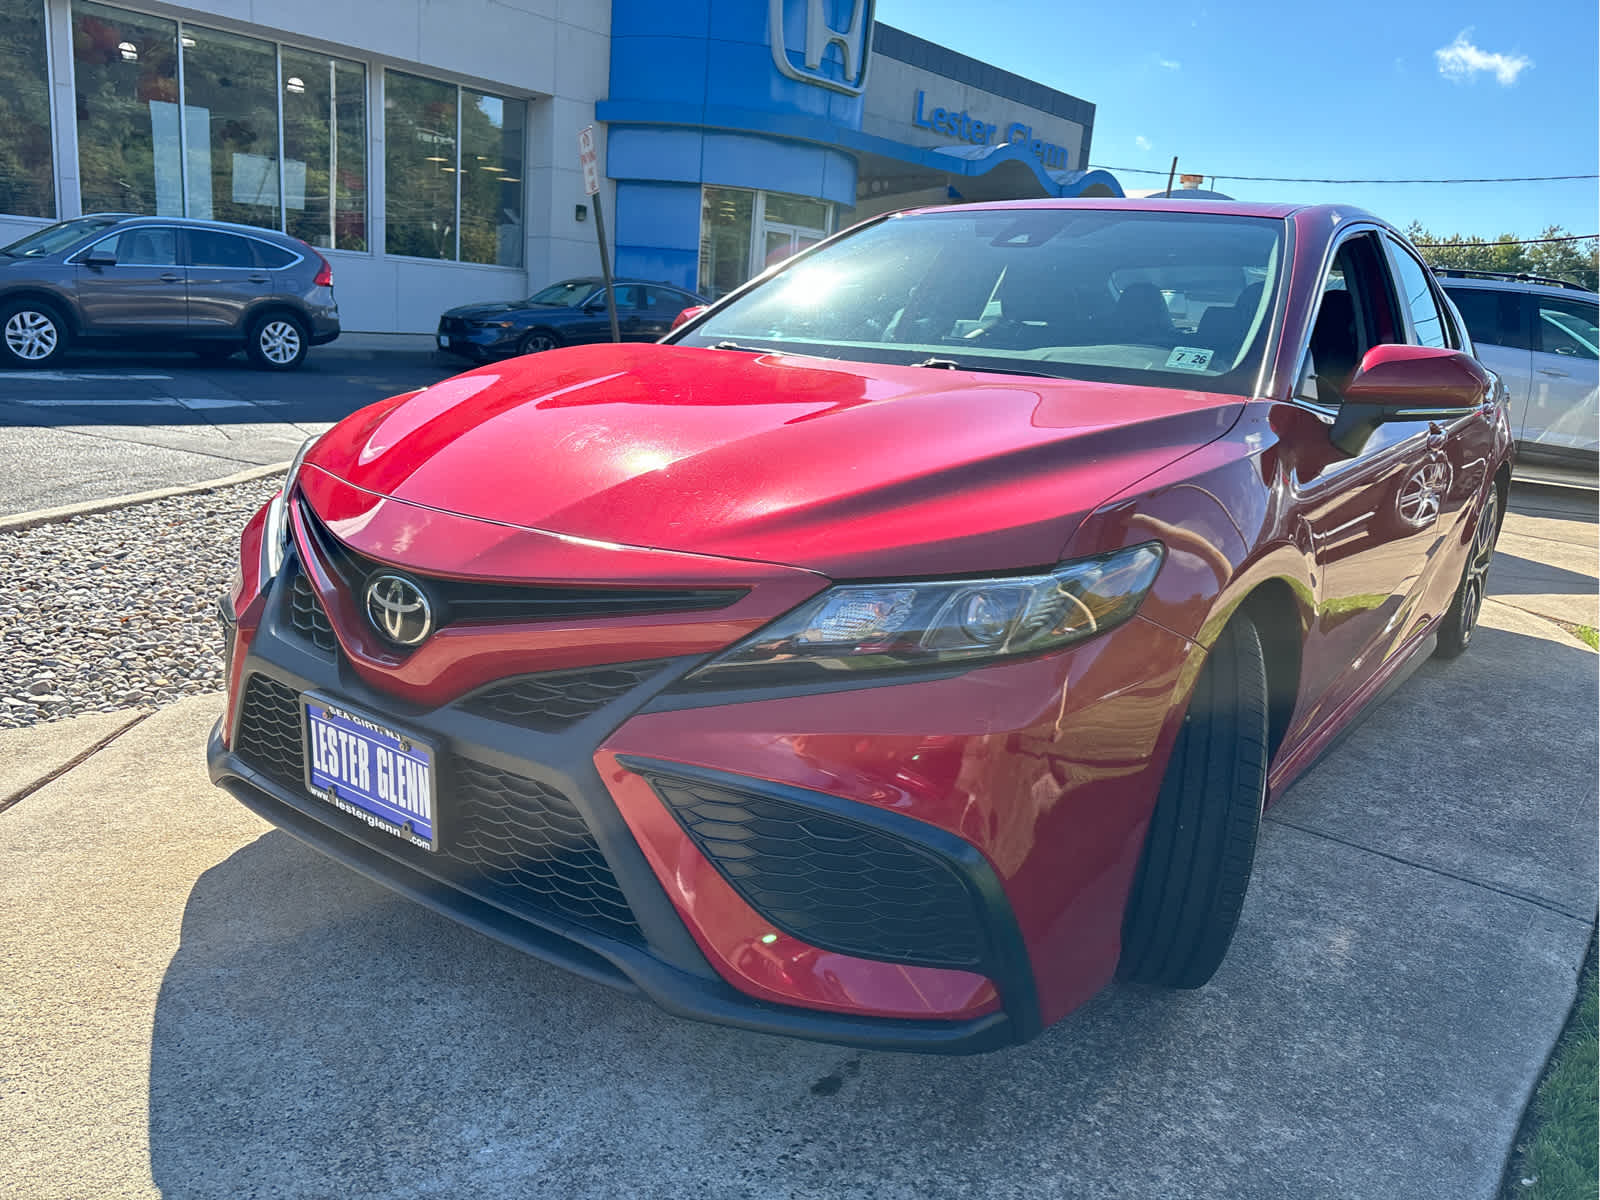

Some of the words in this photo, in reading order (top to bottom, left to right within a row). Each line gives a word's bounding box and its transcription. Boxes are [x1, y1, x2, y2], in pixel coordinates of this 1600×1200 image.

[914, 89, 997, 145] Lester
[1007, 121, 1069, 169] Glenn
[1176, 352, 1186, 361] 7
[1191, 354, 1208, 365] 26
[328, 705, 351, 720] SEA
[310, 719, 370, 793] LESTER
[376, 746, 431, 820] GLENN
[335, 798, 401, 837] lesterglenn
